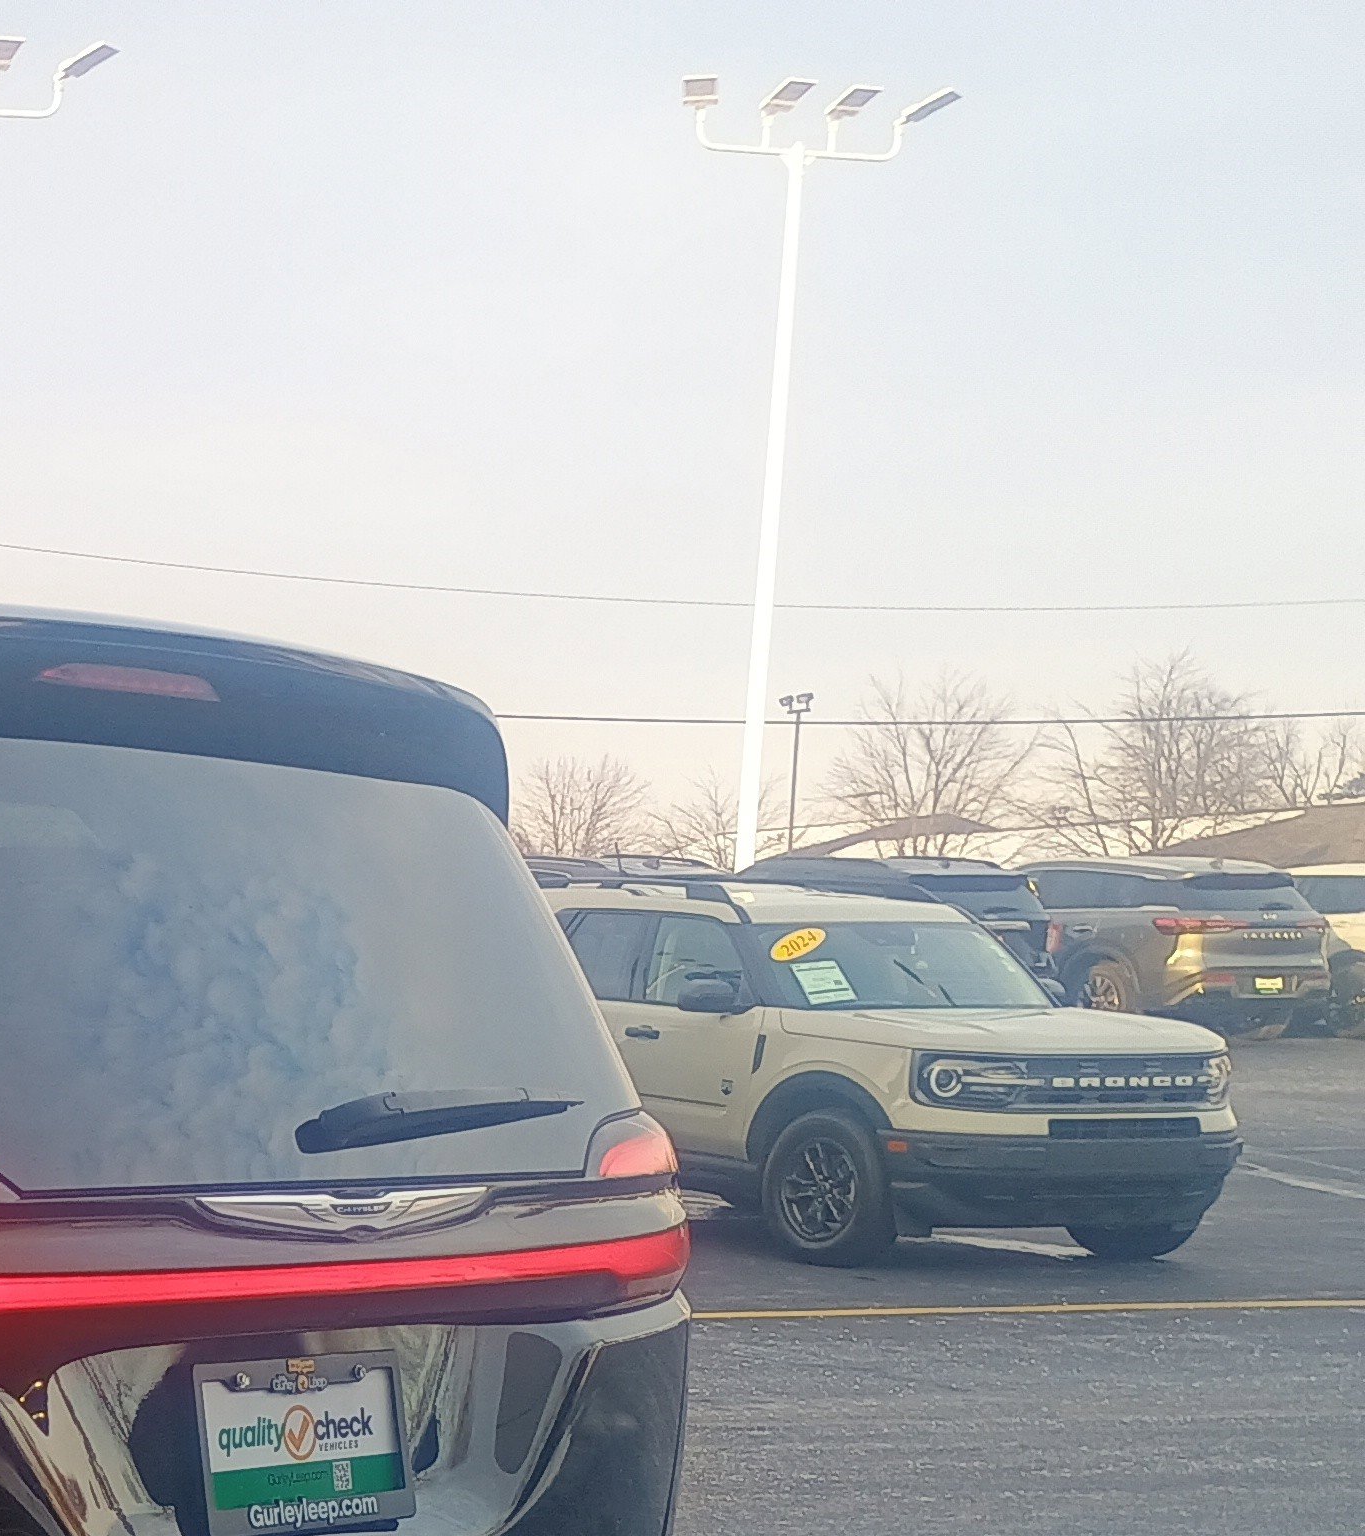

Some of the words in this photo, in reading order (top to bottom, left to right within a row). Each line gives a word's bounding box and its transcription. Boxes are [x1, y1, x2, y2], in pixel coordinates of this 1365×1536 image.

[781, 931, 817, 957] 2024
[1052, 1076, 1194, 1088] BRONCO
[218, 1416, 286, 1458] quality
[313, 1406, 374, 1441] check
[319, 1440, 359, 1451] VEHICLES
